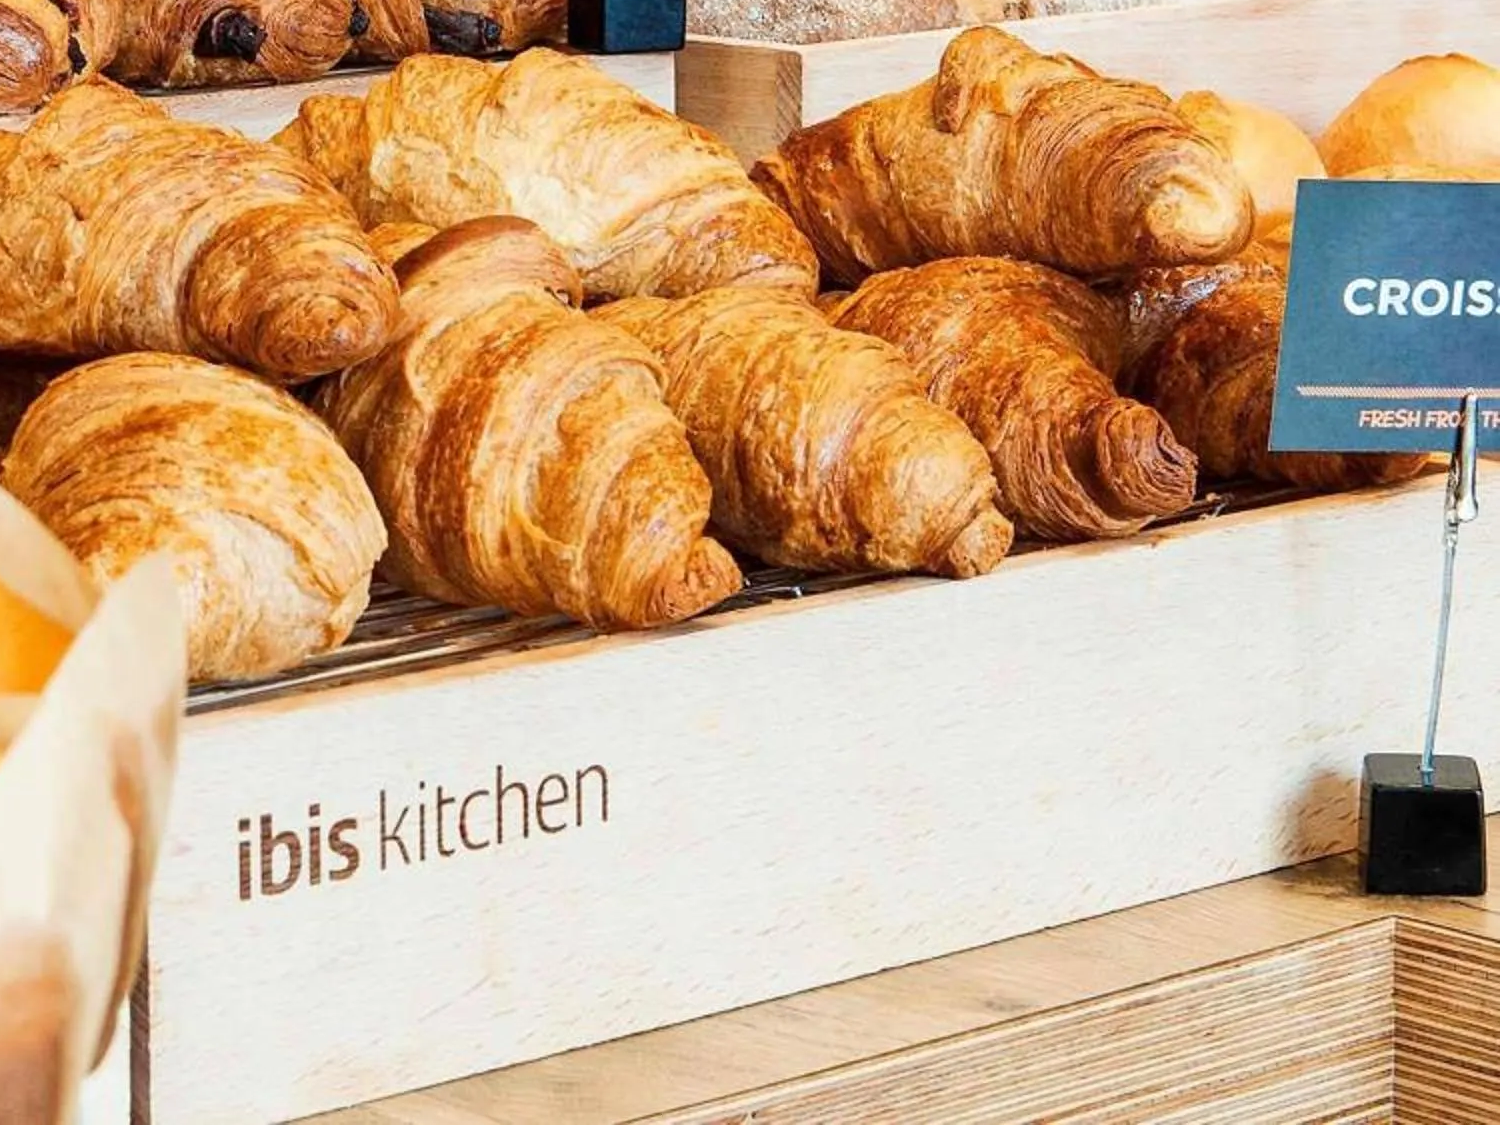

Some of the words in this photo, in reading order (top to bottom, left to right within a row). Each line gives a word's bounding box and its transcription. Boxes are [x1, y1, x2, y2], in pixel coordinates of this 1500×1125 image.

[1343, 278, 1500, 317] CROIS
[1359, 409, 1421, 428] FRESH
[1424, 410, 1470, 428] FRO
[238, 803, 361, 901] ibis
[379, 764, 609, 871] kitchen
